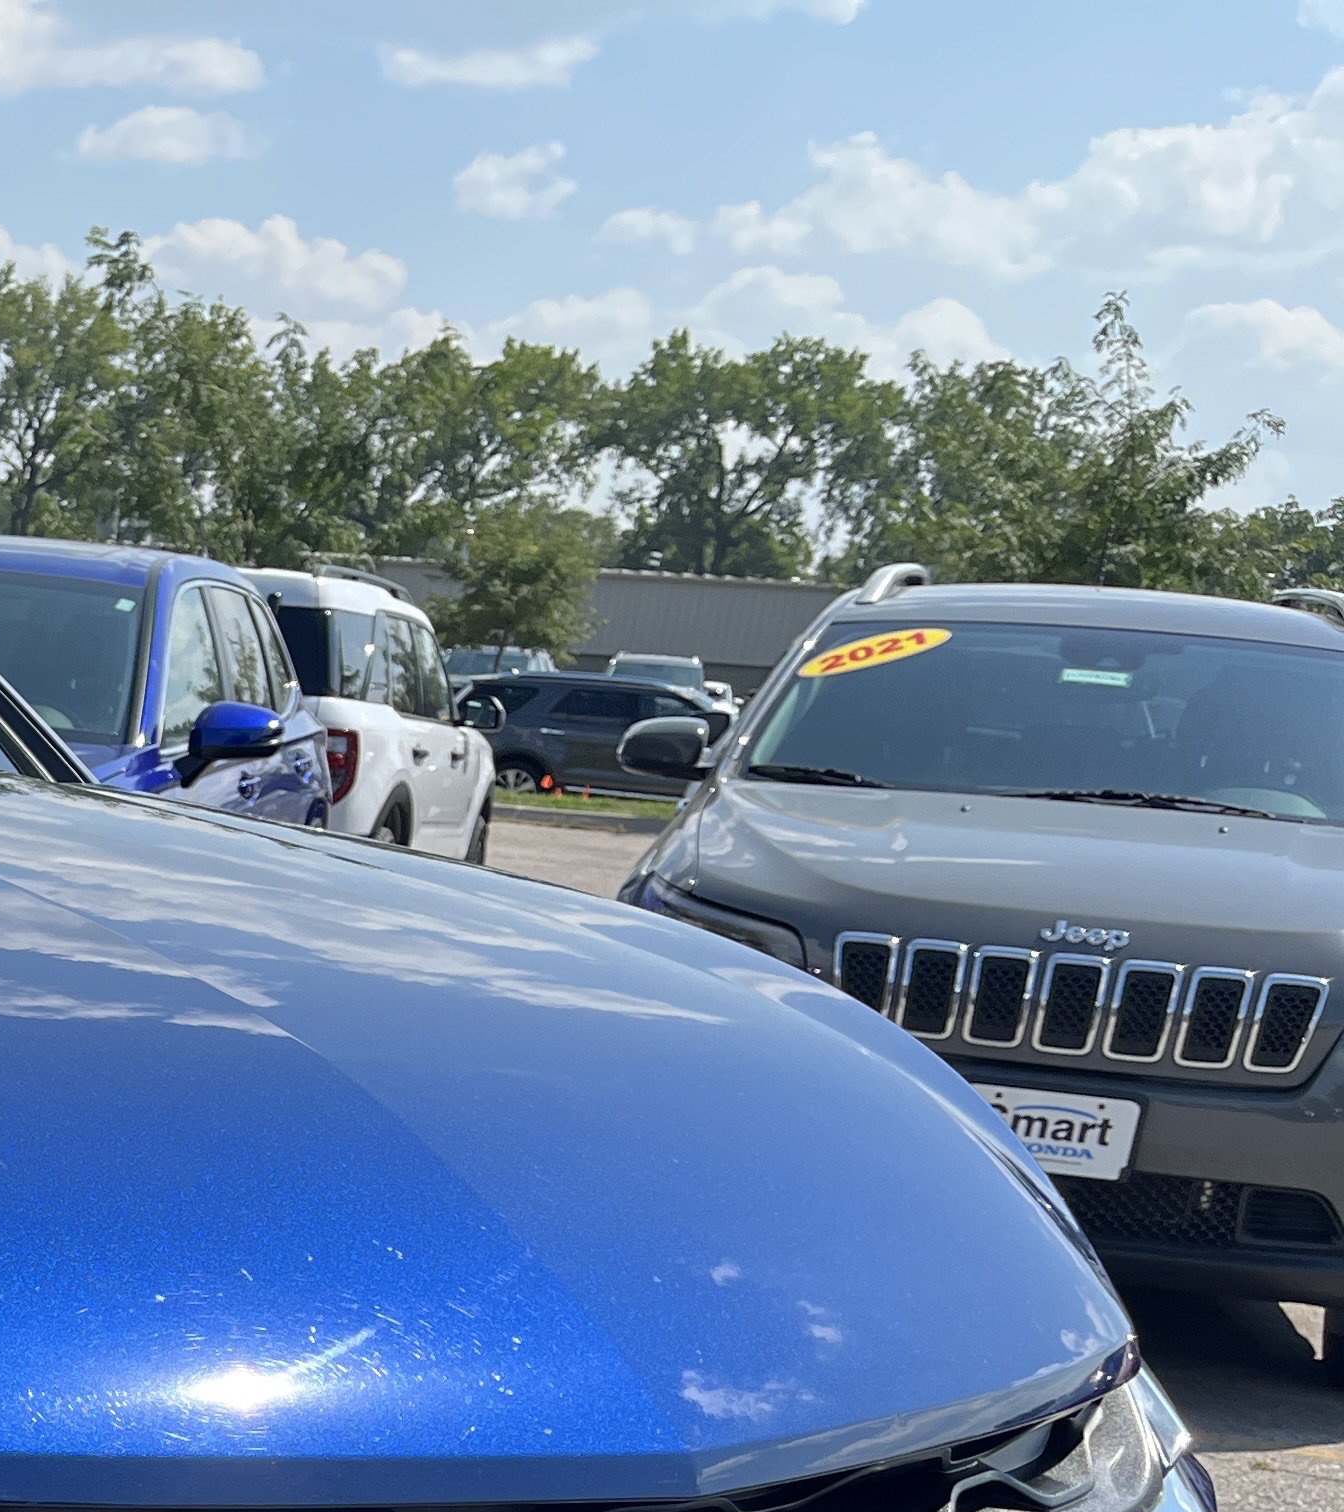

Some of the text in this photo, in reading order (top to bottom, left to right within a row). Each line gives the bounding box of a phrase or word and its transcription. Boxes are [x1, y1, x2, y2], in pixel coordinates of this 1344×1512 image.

[819, 630, 927, 672] 2021
[1040, 920, 1130, 951] Jeep
[991, 1102, 1114, 1147] mart
[1026, 1143, 1094, 1160] ONDA
